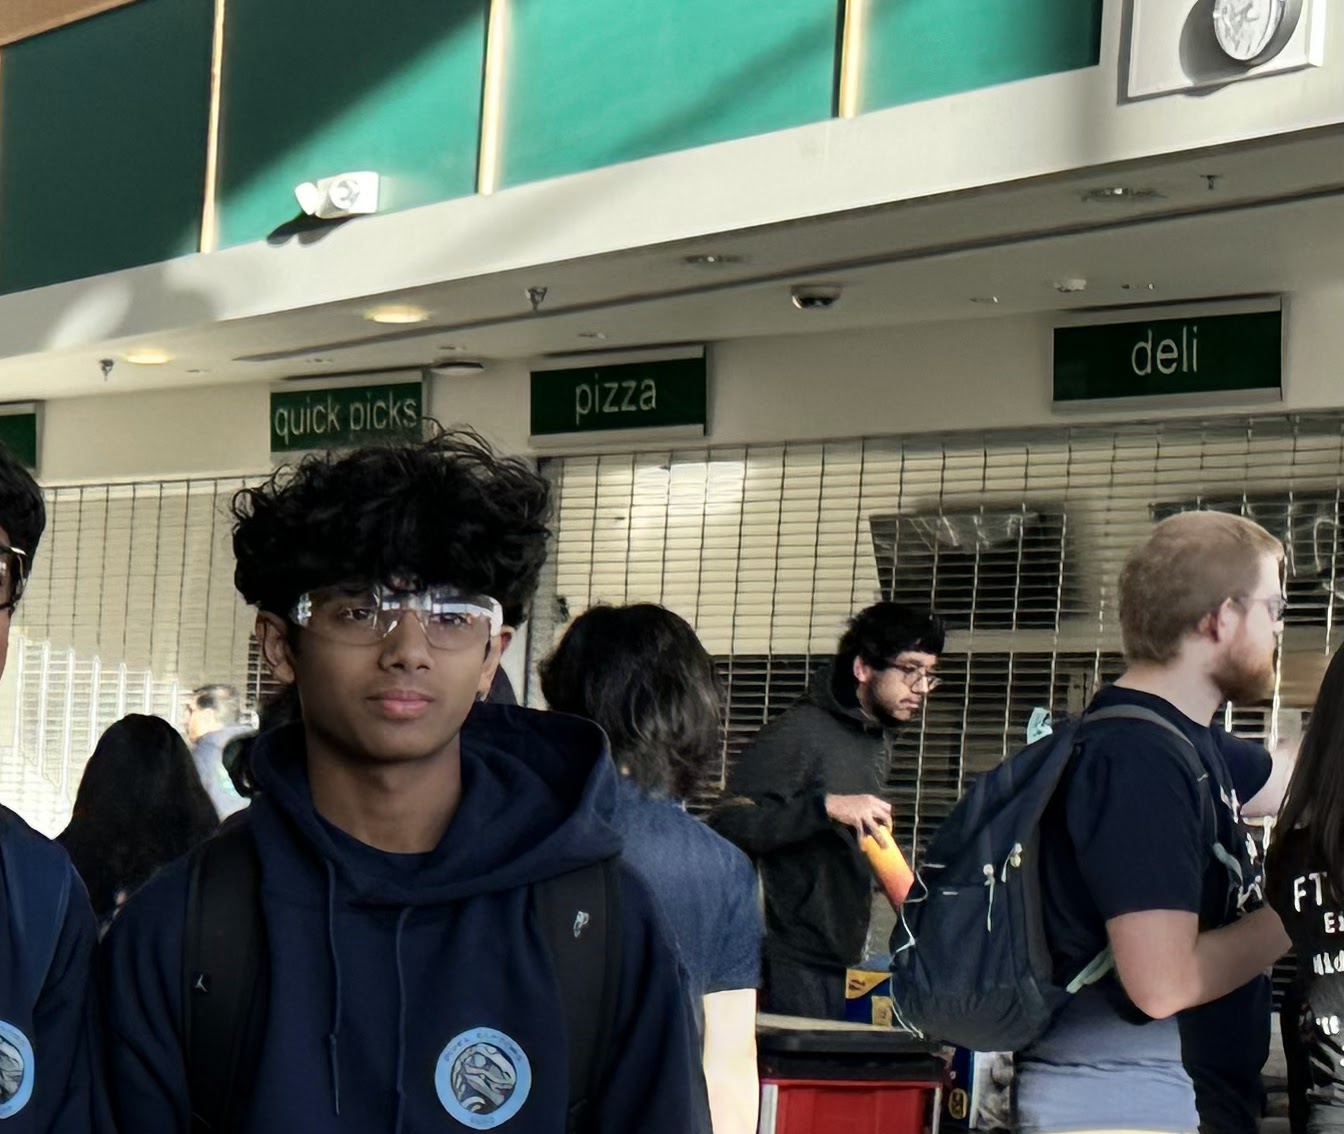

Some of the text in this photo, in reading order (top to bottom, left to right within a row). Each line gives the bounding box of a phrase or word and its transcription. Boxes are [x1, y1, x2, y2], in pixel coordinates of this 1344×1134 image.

[1132, 325, 1197, 376] deli
[274, 390, 417, 445] quick picks
[575, 372, 657, 426] pizza
